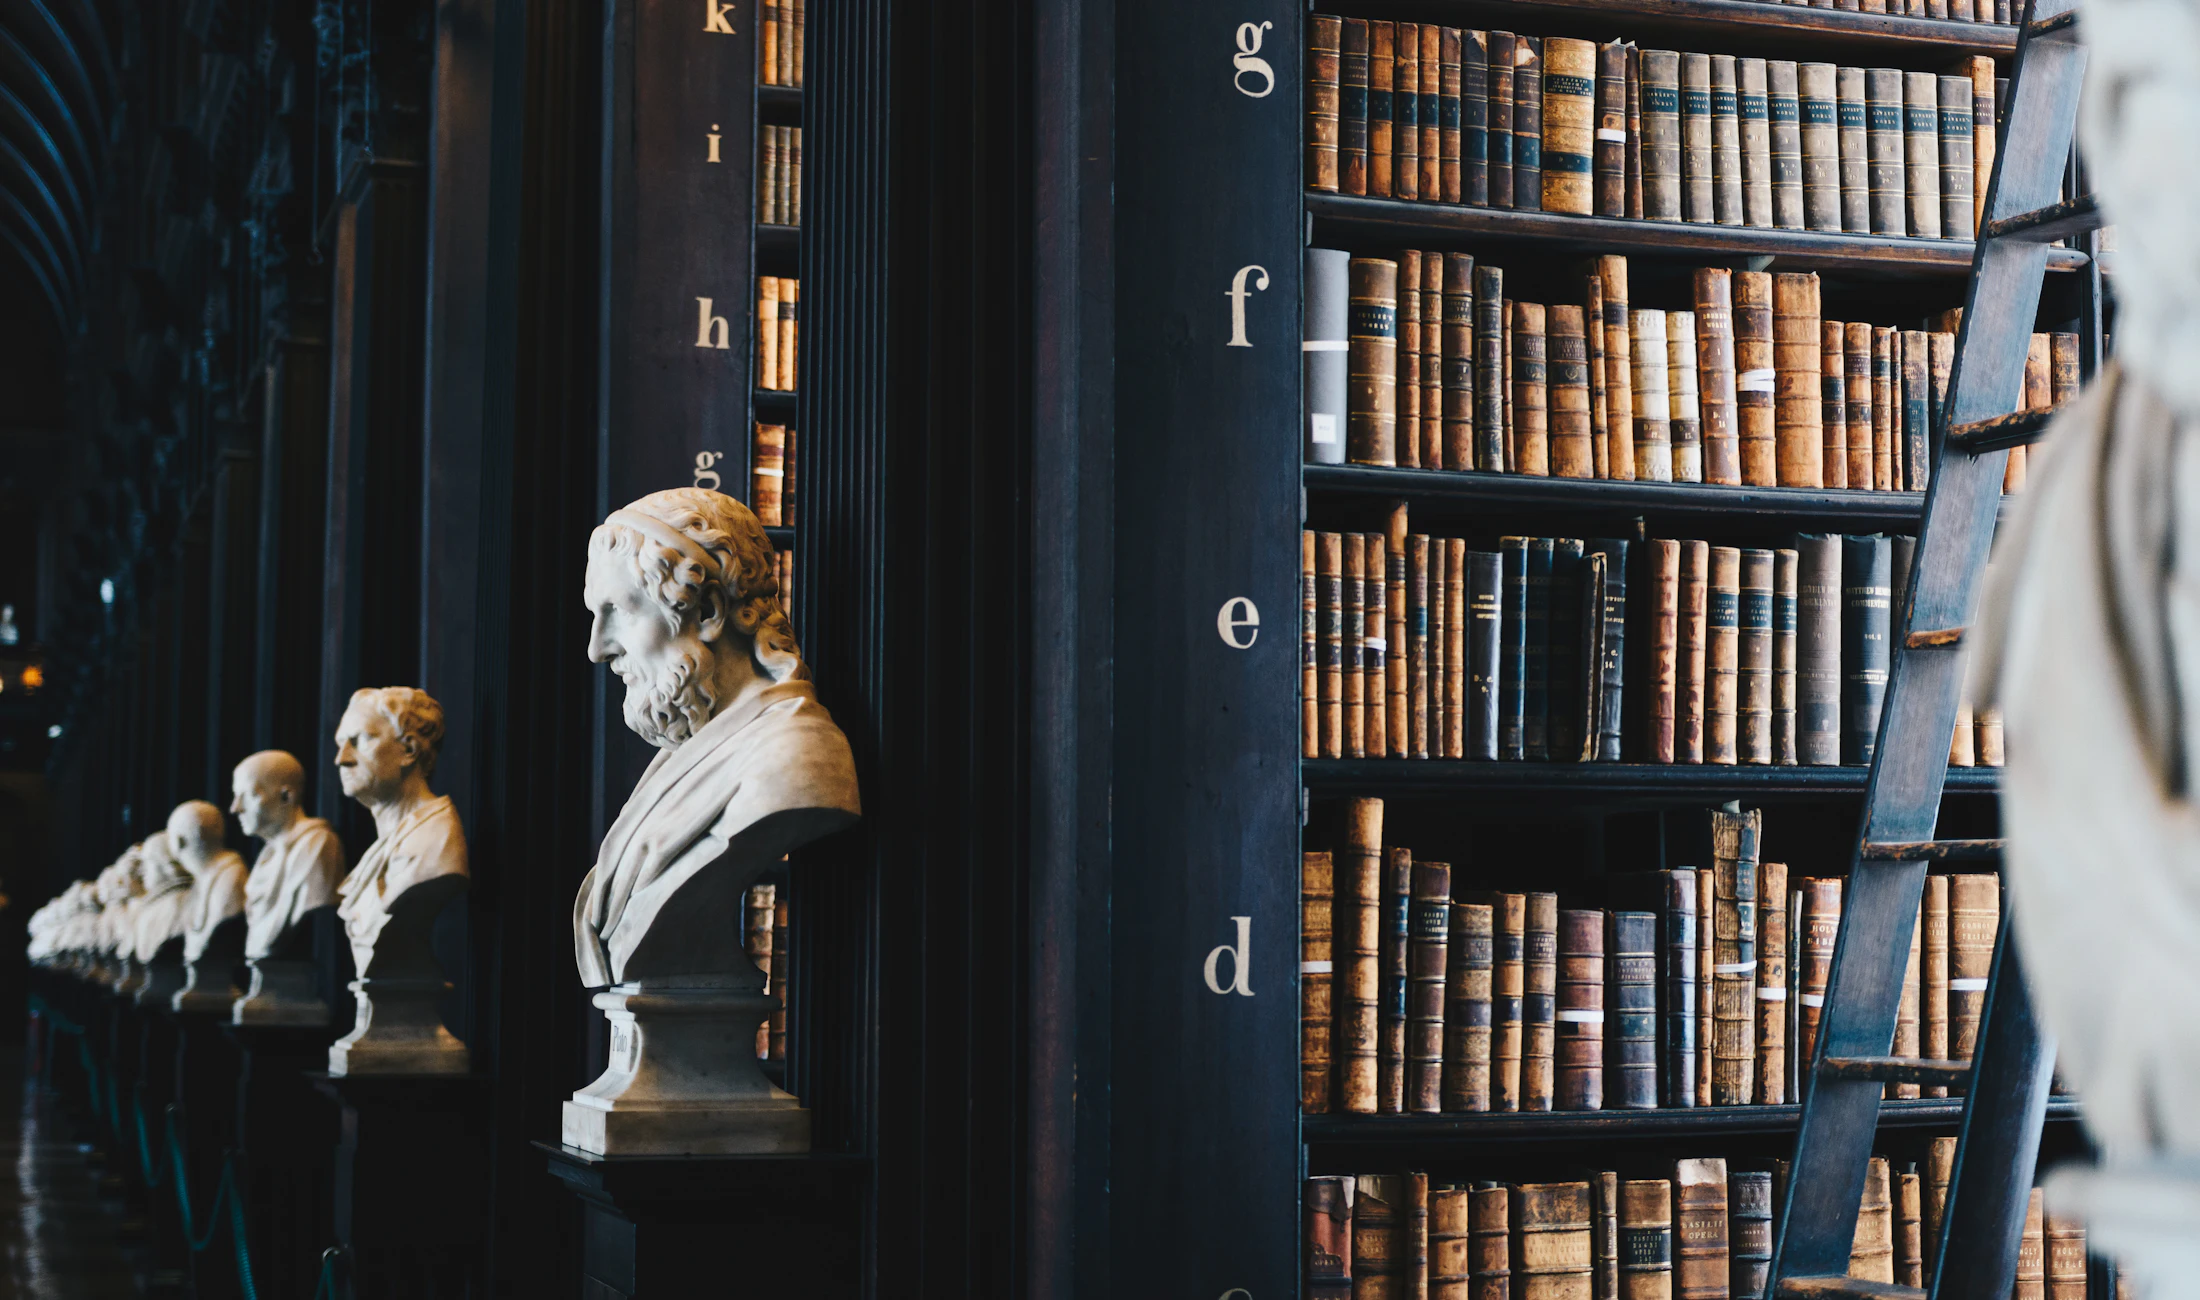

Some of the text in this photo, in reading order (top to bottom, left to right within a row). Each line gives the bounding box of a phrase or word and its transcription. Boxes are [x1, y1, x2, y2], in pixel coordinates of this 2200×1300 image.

[703, 0, 736, 35] k
[1233, 20, 1275, 99] g
[707, 123, 722, 163] i
[695, 296, 730, 350] h
[1224, 264, 1270, 348] f
[692, 450, 723, 491] g
[1217, 596, 1261, 650] e
[1203, 915, 1255, 998] d
[1808, 938, 1834, 946] BIBL
[1688, 1231, 1718, 1240] OPERA
[2054, 1260, 2082, 1269] BIBLE
